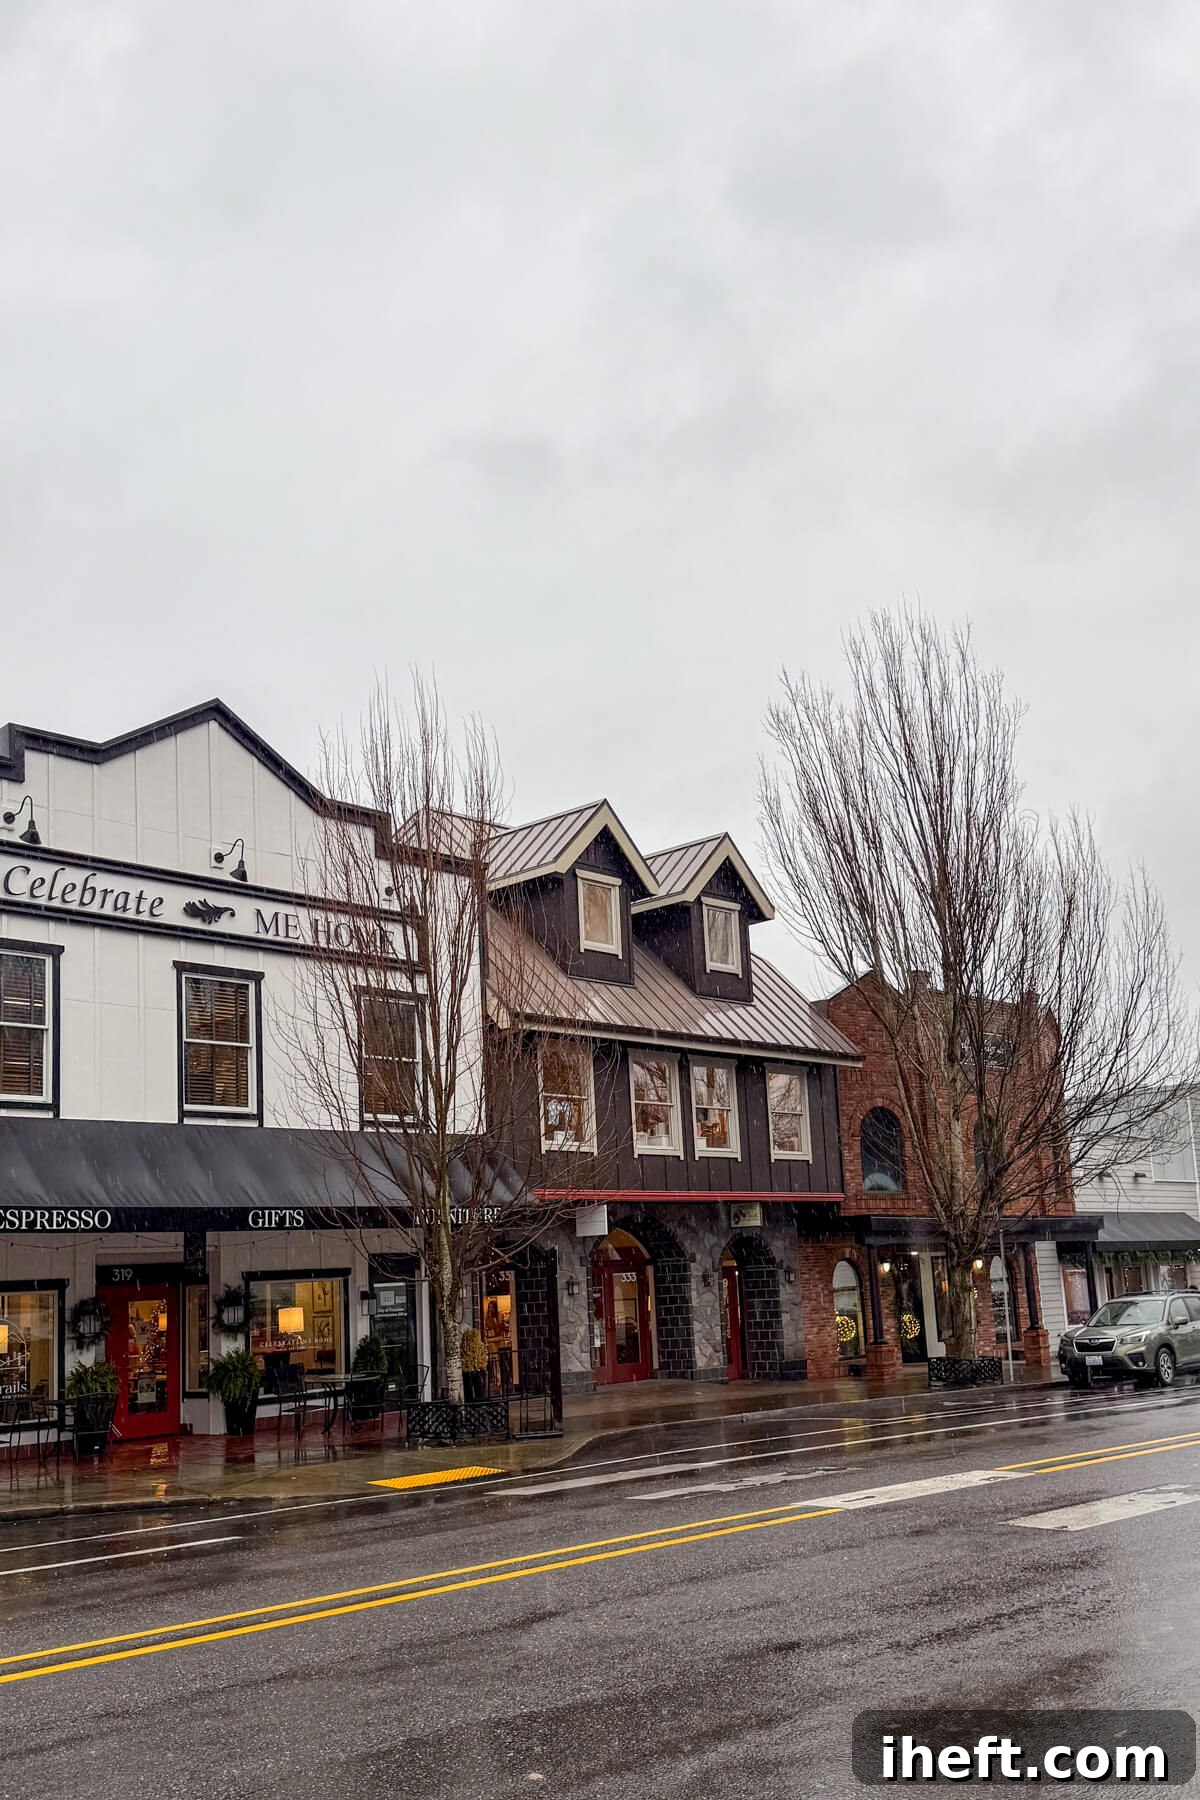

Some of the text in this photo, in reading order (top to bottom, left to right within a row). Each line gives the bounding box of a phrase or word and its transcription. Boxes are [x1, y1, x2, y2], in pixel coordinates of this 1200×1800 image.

[3, 865, 395, 955] Celebrate ME HOME
[248, 1209, 304, 1228] GIFTS
[112, 1268, 133, 1281] 319
